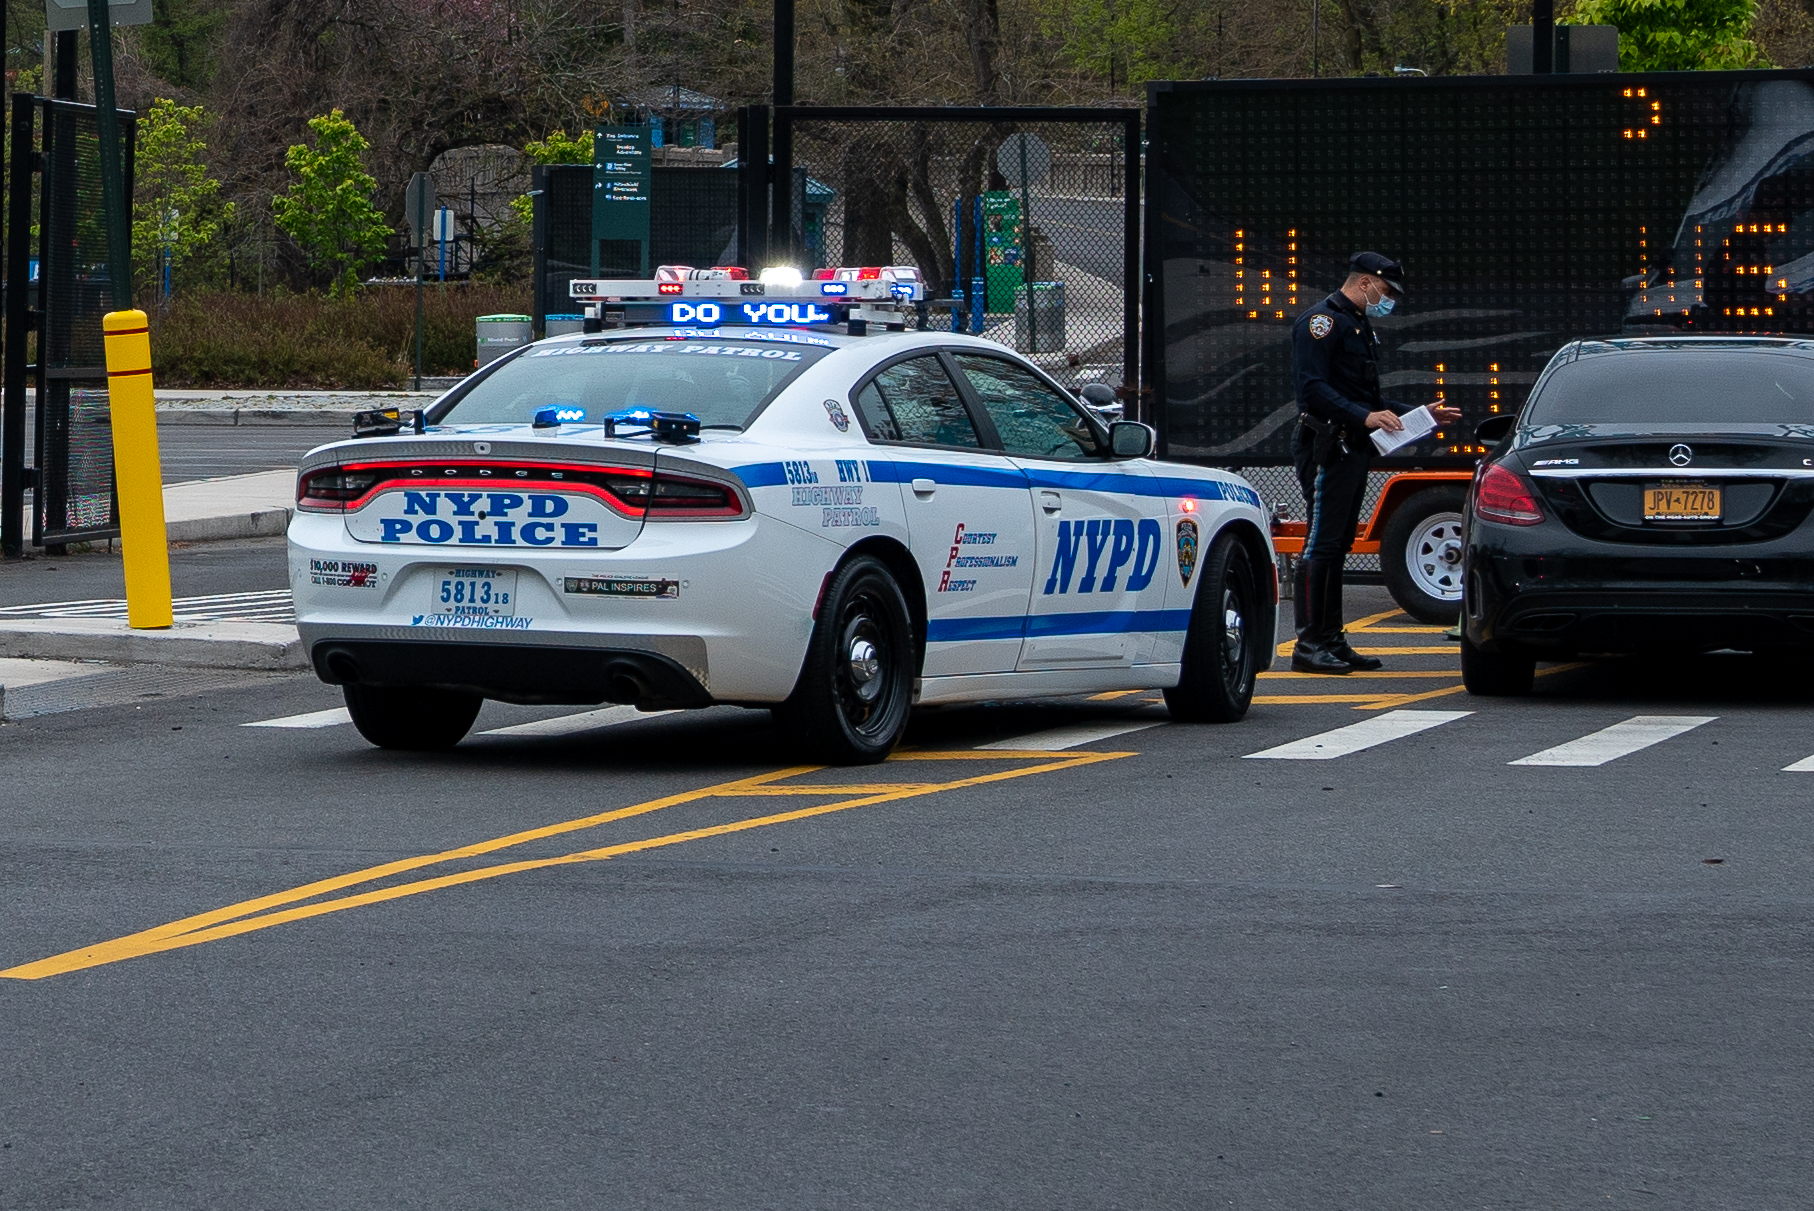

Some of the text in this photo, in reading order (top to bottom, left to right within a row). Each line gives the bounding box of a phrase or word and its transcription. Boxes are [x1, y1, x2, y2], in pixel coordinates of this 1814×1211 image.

[672, 303, 720, 322] DO
[530, 345, 802, 360] HIGHWAY PATROL
[1802, 458, 1812, 466] C
[411, 469, 564, 479] DODGE
[785, 460, 812, 484] 5813
[834, 460, 861, 482] HWY
[403, 492, 569, 518] NYPD
[792, 486, 863, 506] HIGHWAY
[1648, 491, 1714, 510] JPV 7278
[822, 507, 880, 527] PATROL
[380, 518, 598, 546] POLICE
[1044, 519, 1161, 594] NYPD
[310, 559, 378, 574] $10,000 REWARD
[454, 570, 496, 578] HIGHWAY
[440, 580, 509, 604] 5813 18
[592, 582, 656, 592] PAL INSPIRES
[454, 606, 490, 616] PATROL
[425, 615, 533, 628] @NYPDHIGHWAY
